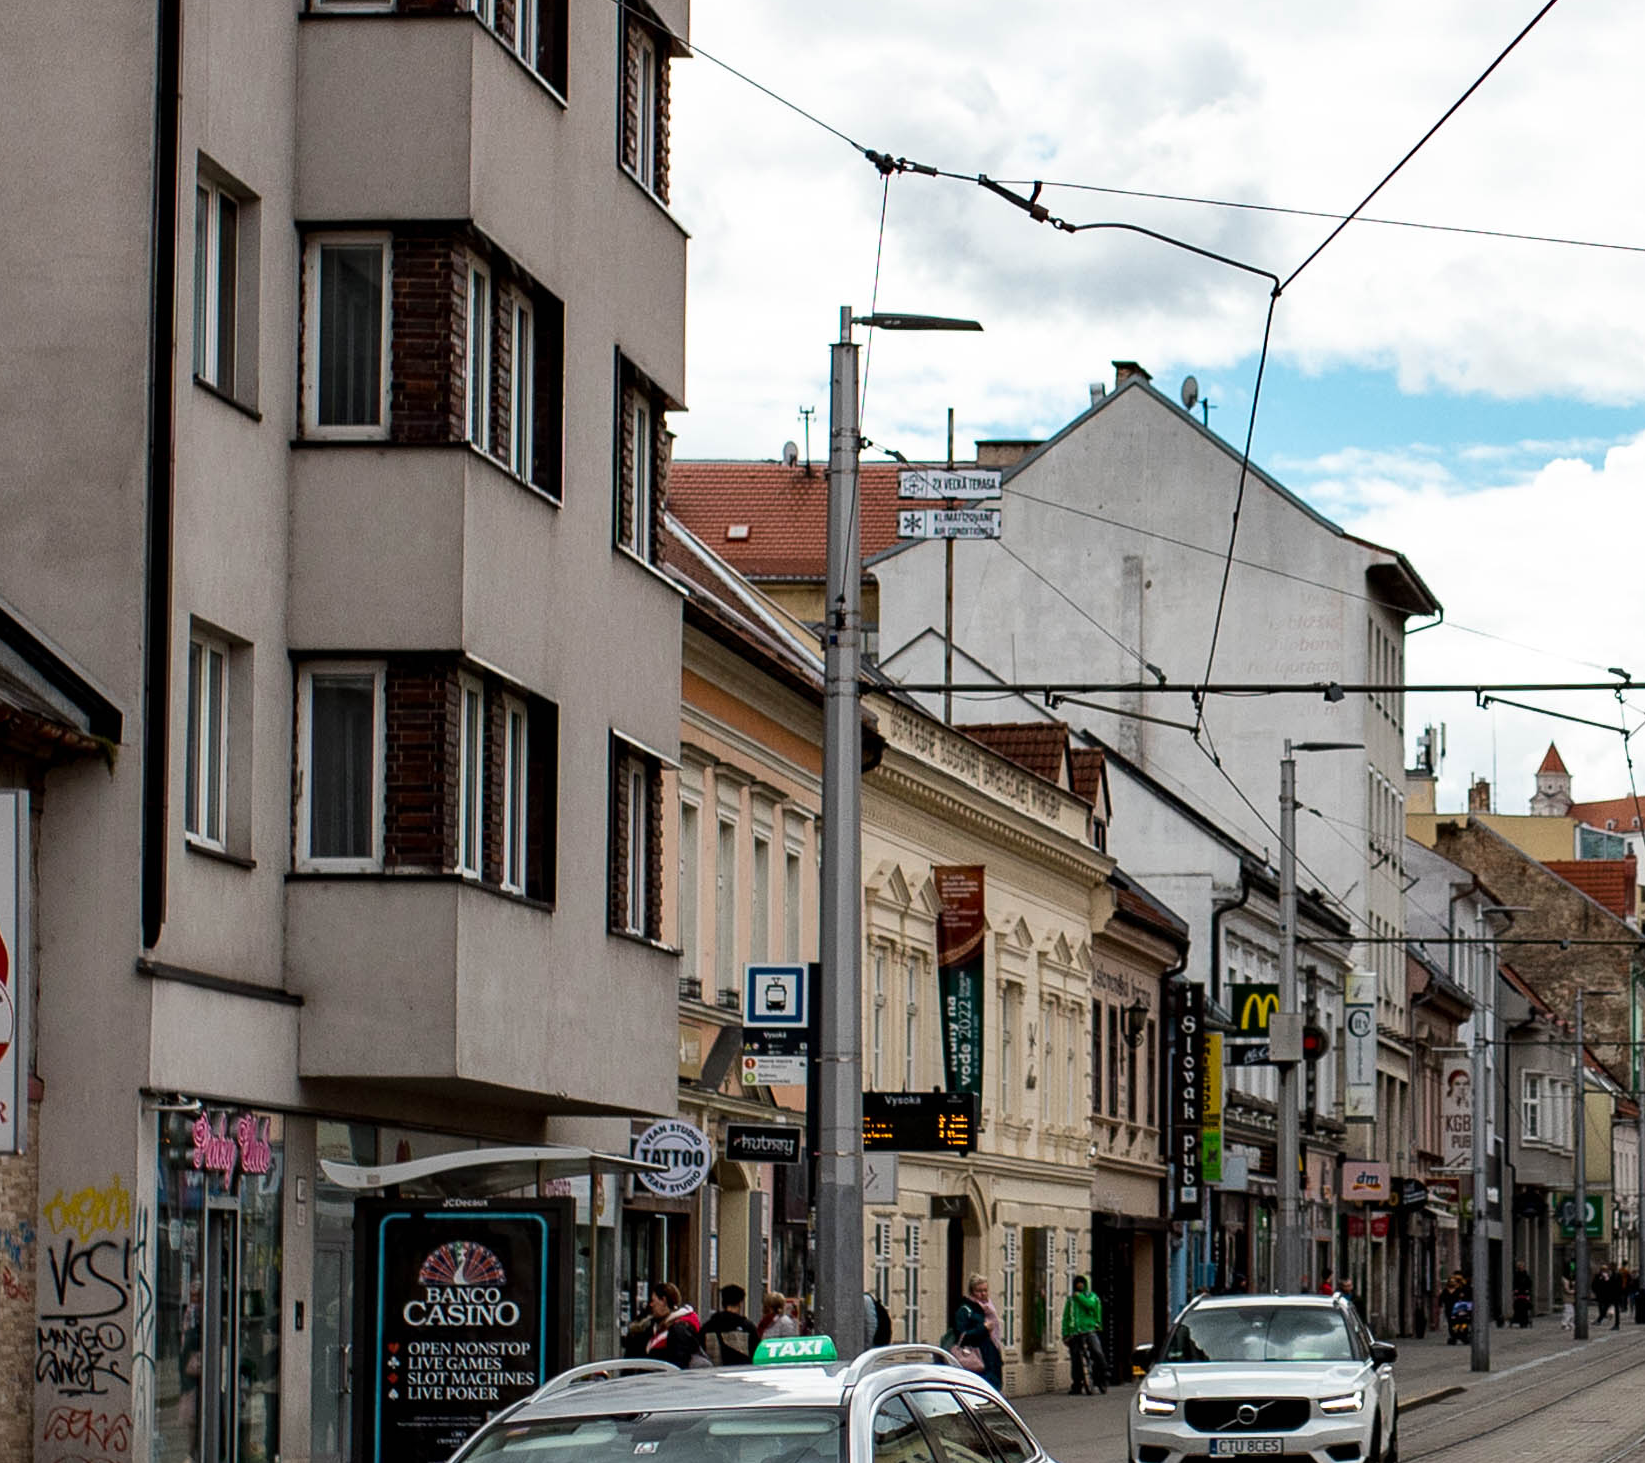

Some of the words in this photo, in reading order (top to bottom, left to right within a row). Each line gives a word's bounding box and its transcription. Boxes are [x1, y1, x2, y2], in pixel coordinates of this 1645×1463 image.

[958, 1000, 972, 1039] 2022
[958, 1043, 972, 1086] vode
[1181, 1015, 1196, 1121] Slovak
[1445, 1114, 1472, 1133] KGB
[669, 1123, 702, 1147] STUDIO
[640, 1148, 705, 1167] TATTOO
[1183, 1134, 1195, 1185] pub
[669, 1170, 702, 1193] STUDIO
[1356, 1171, 1380, 1185] dm
[442, 1198, 488, 1208] JCDecaux
[425, 1287, 502, 1304] BANCO
[403, 1300, 521, 1326] CASINO
[407, 1342, 451, 1356] OPEN
[451, 1342, 531, 1356] NONSTOP
[765, 1339, 824, 1358] TAXI
[407, 1356, 444, 1370] LIVE
[445, 1356, 503, 1371] GAMES
[407, 1371, 449, 1386] SLOT
[451, 1371, 535, 1386] MACHINES
[407, 1387, 444, 1400] LIVE
[446, 1387, 500, 1400] POKER
[1218, 1440, 1244, 1454] CTU
